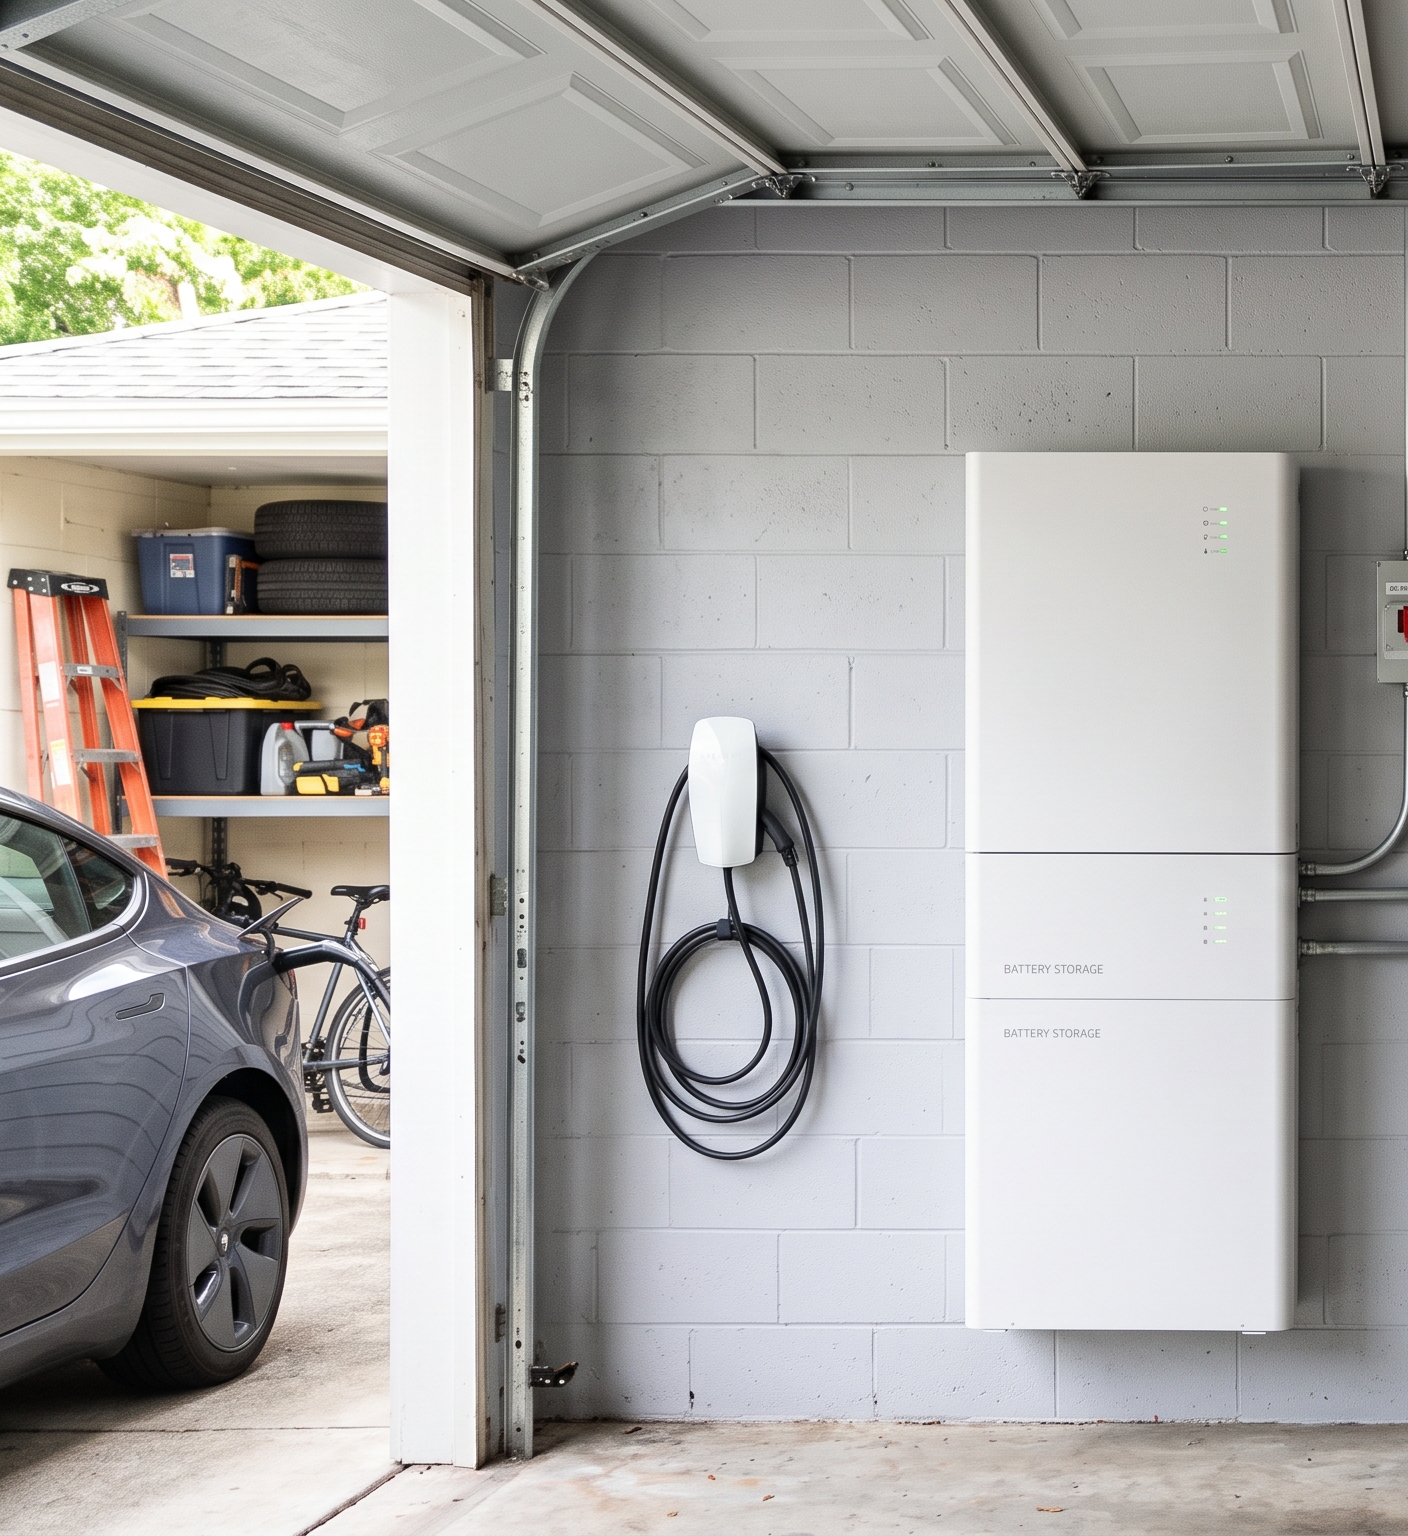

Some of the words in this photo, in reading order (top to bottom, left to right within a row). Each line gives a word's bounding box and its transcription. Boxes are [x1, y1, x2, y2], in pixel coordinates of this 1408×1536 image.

[1004, 964, 1052, 975] BATTERY
[1054, 964, 1104, 975] STORAGE
[1003, 1028, 1050, 1039] BATTERY
[1052, 1028, 1101, 1039] STORAGE
